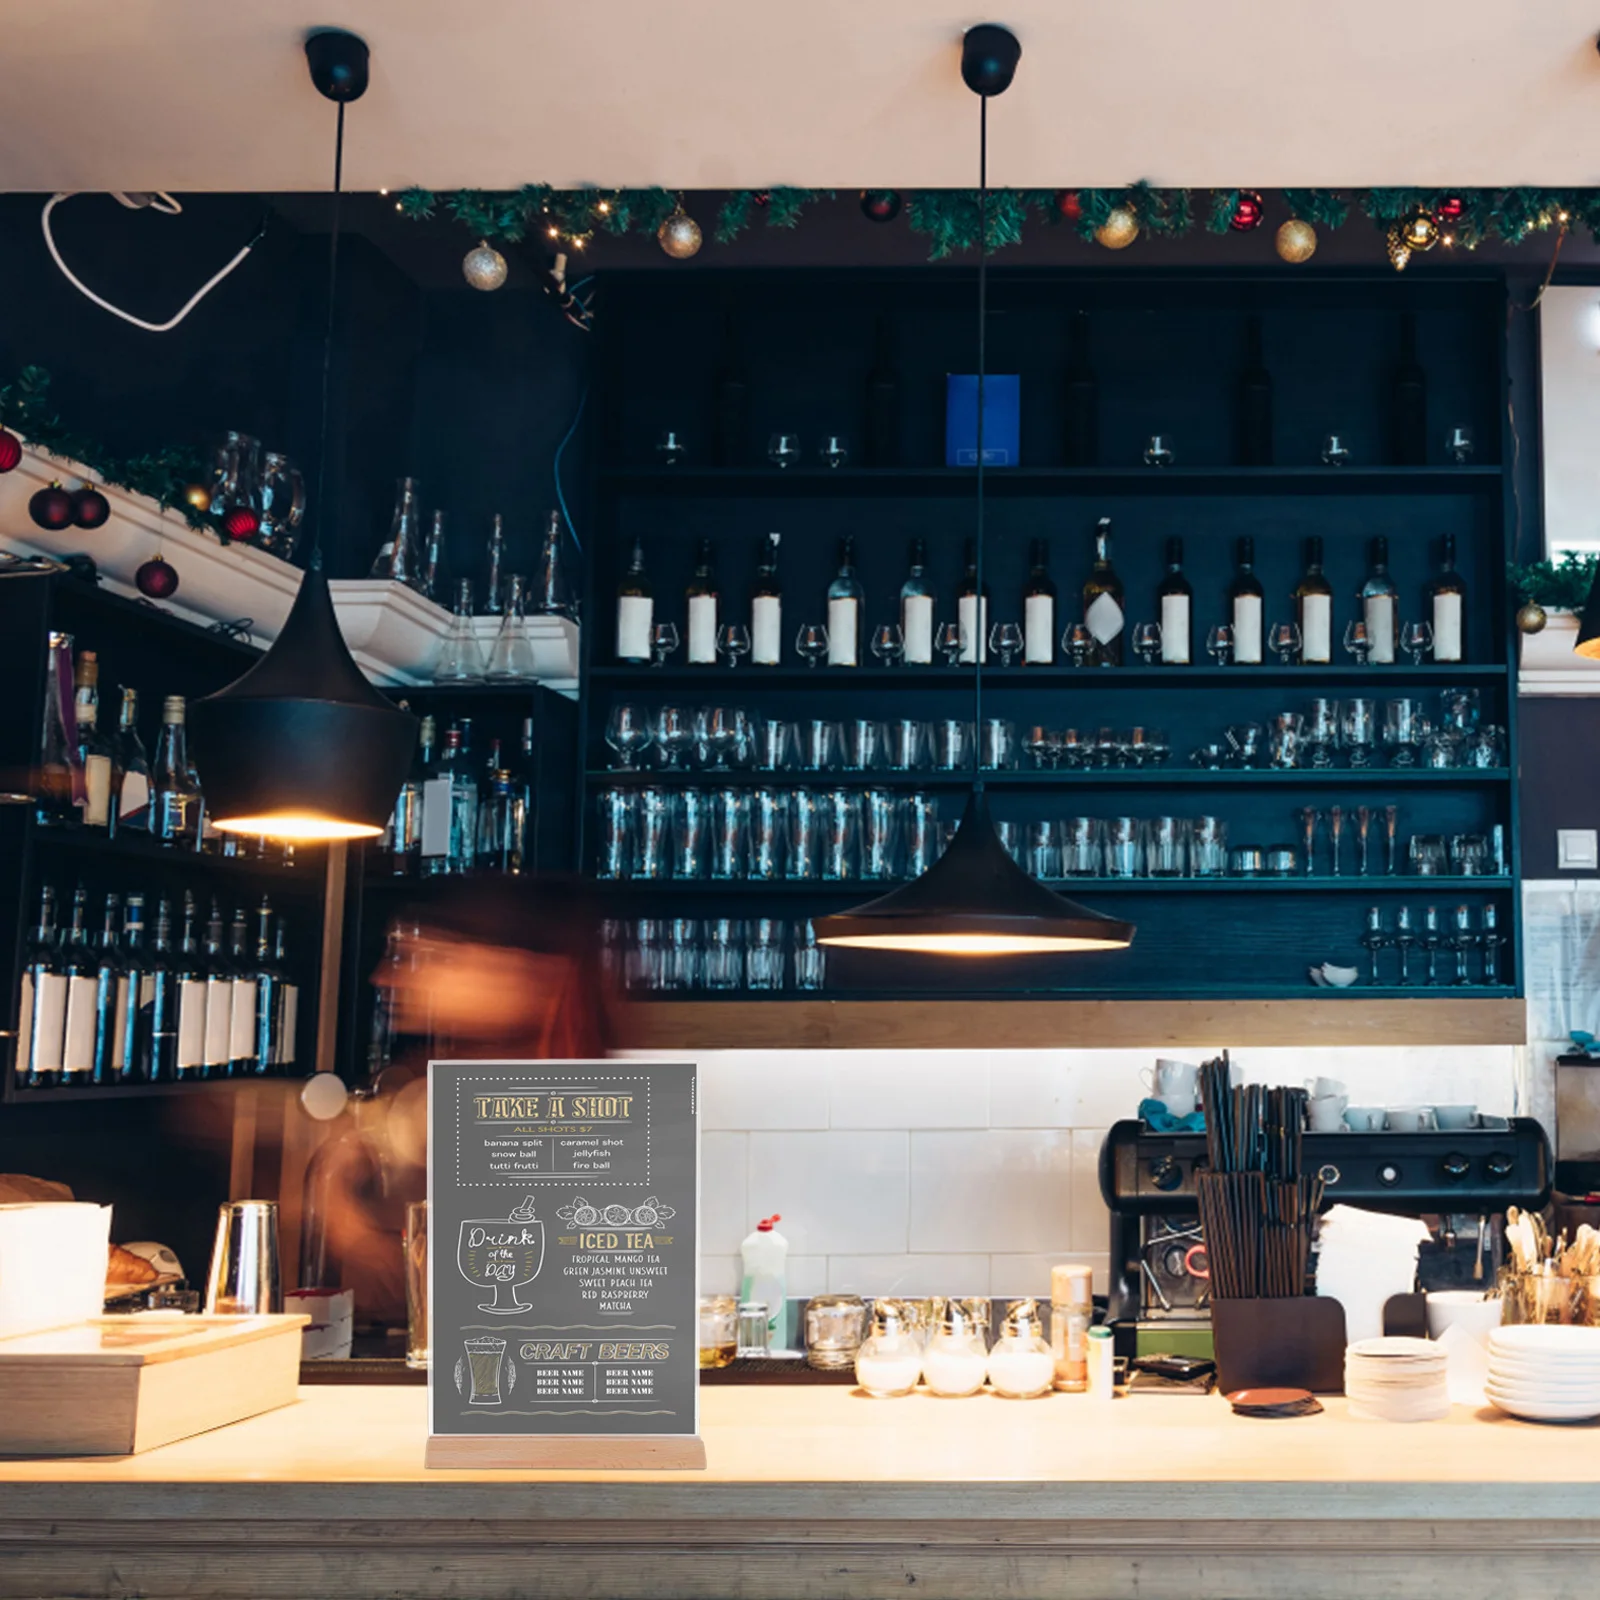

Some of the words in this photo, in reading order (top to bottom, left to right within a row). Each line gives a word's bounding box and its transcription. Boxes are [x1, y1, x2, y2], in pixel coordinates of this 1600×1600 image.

[473, 1096, 539, 1119] TAKE
[545, 1096, 565, 1119] A
[571, 1096, 633, 1119] SHOT
[484, 1139, 519, 1147] banana
[522, 1139, 543, 1148] split
[560, 1139, 599, 1147] caramel
[602, 1139, 624, 1147] shot
[519, 1150, 537, 1158] ball
[572, 1149, 611, 1158] jellyfish
[489, 1162, 511, 1170] tutti
[513, 1162, 539, 1170] frutti
[592, 1161, 610, 1169] ball
[468, 1227, 535, 1248] Drink
[579, 1233, 619, 1249] ICED
[625, 1233, 654, 1249] TEA
[488, 1250, 499, 1260] of
[499, 1248, 514, 1259] the
[572, 1254, 610, 1264] TROPICAL
[614, 1254, 644, 1264] MANGO
[647, 1254, 660, 1264] TEA
[563, 1267, 589, 1276] GREEN
[591, 1266, 626, 1277] JASMINE
[629, 1266, 668, 1276] UNSWEET
[579, 1278, 606, 1288] SWEET
[610, 1279, 636, 1288] PEACH
[639, 1279, 653, 1288] TEA
[581, 1290, 598, 1299] RED
[601, 1290, 649, 1299] RASPBERRY
[599, 1301, 632, 1311] MATCHA
[519, 1342, 593, 1360] CRAFT
[598, 1342, 670, 1360] BEERS
[536, 1369, 560, 1377] BEER
[561, 1369, 584, 1377] NAME
[606, 1369, 629, 1377] BEER
[631, 1369, 654, 1377] NAME
[536, 1378, 560, 1386] BEER
[561, 1378, 584, 1386] NAME
[606, 1378, 629, 1386] BEER
[631, 1378, 654, 1386] NAME
